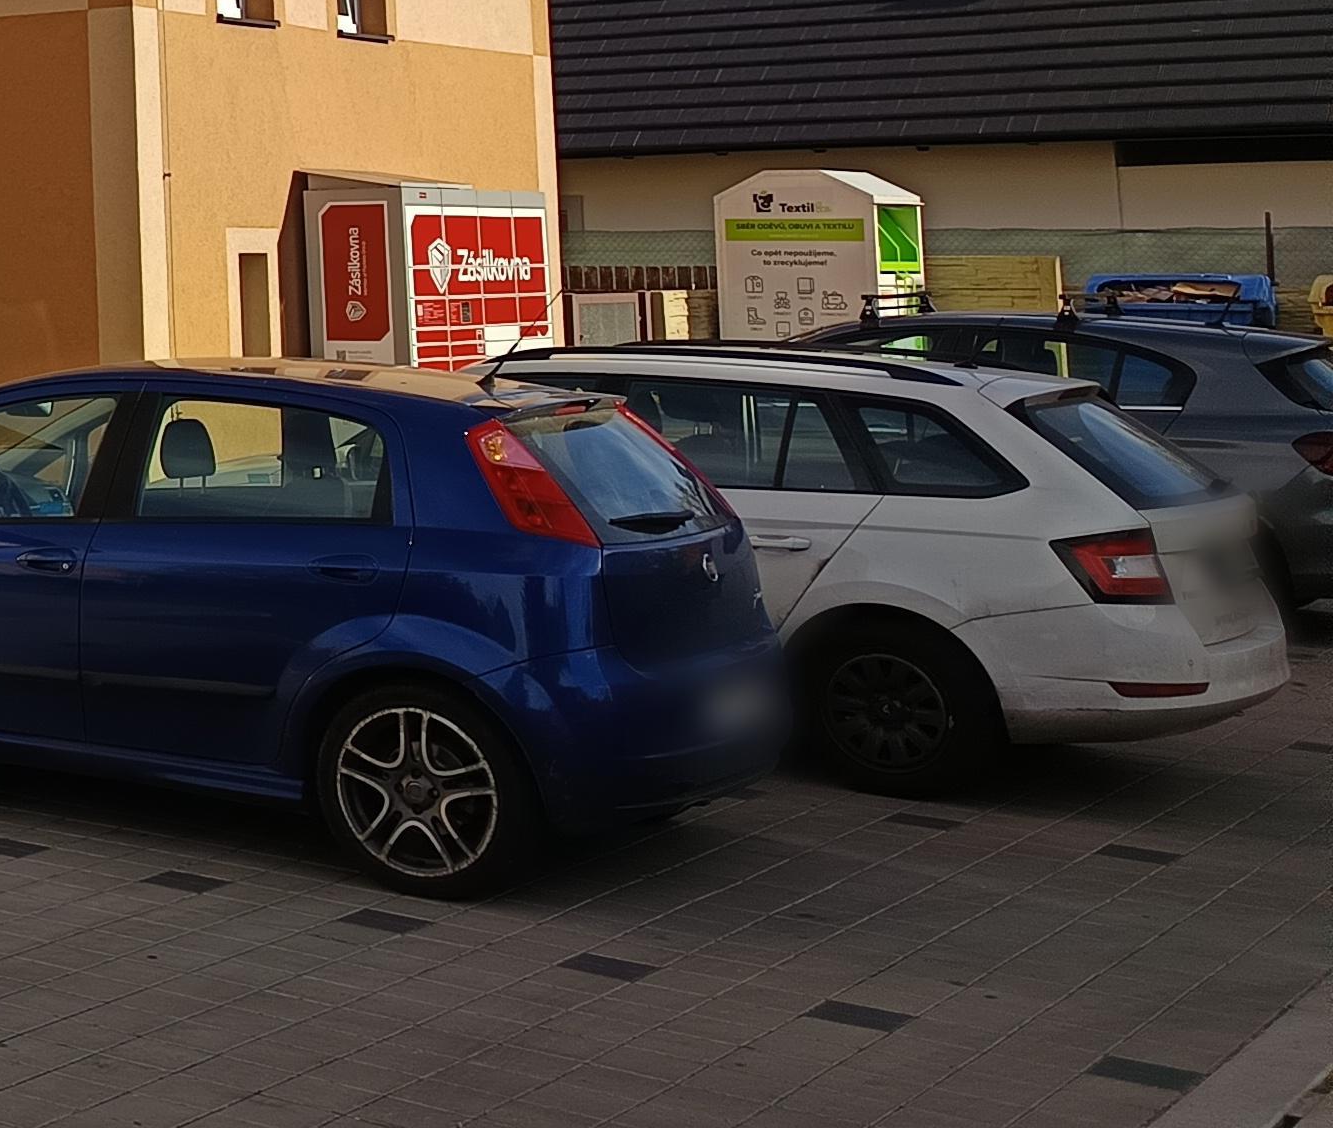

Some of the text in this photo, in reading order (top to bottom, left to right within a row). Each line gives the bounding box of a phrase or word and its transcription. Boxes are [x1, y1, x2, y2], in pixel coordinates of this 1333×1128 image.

[779, 202, 814, 213] Textil
[347, 227, 362, 296] Zásilkovna
[751, 249, 763, 257] Co
[763, 249, 782, 258] opět
[456, 248, 531, 282] Zásilkovna
